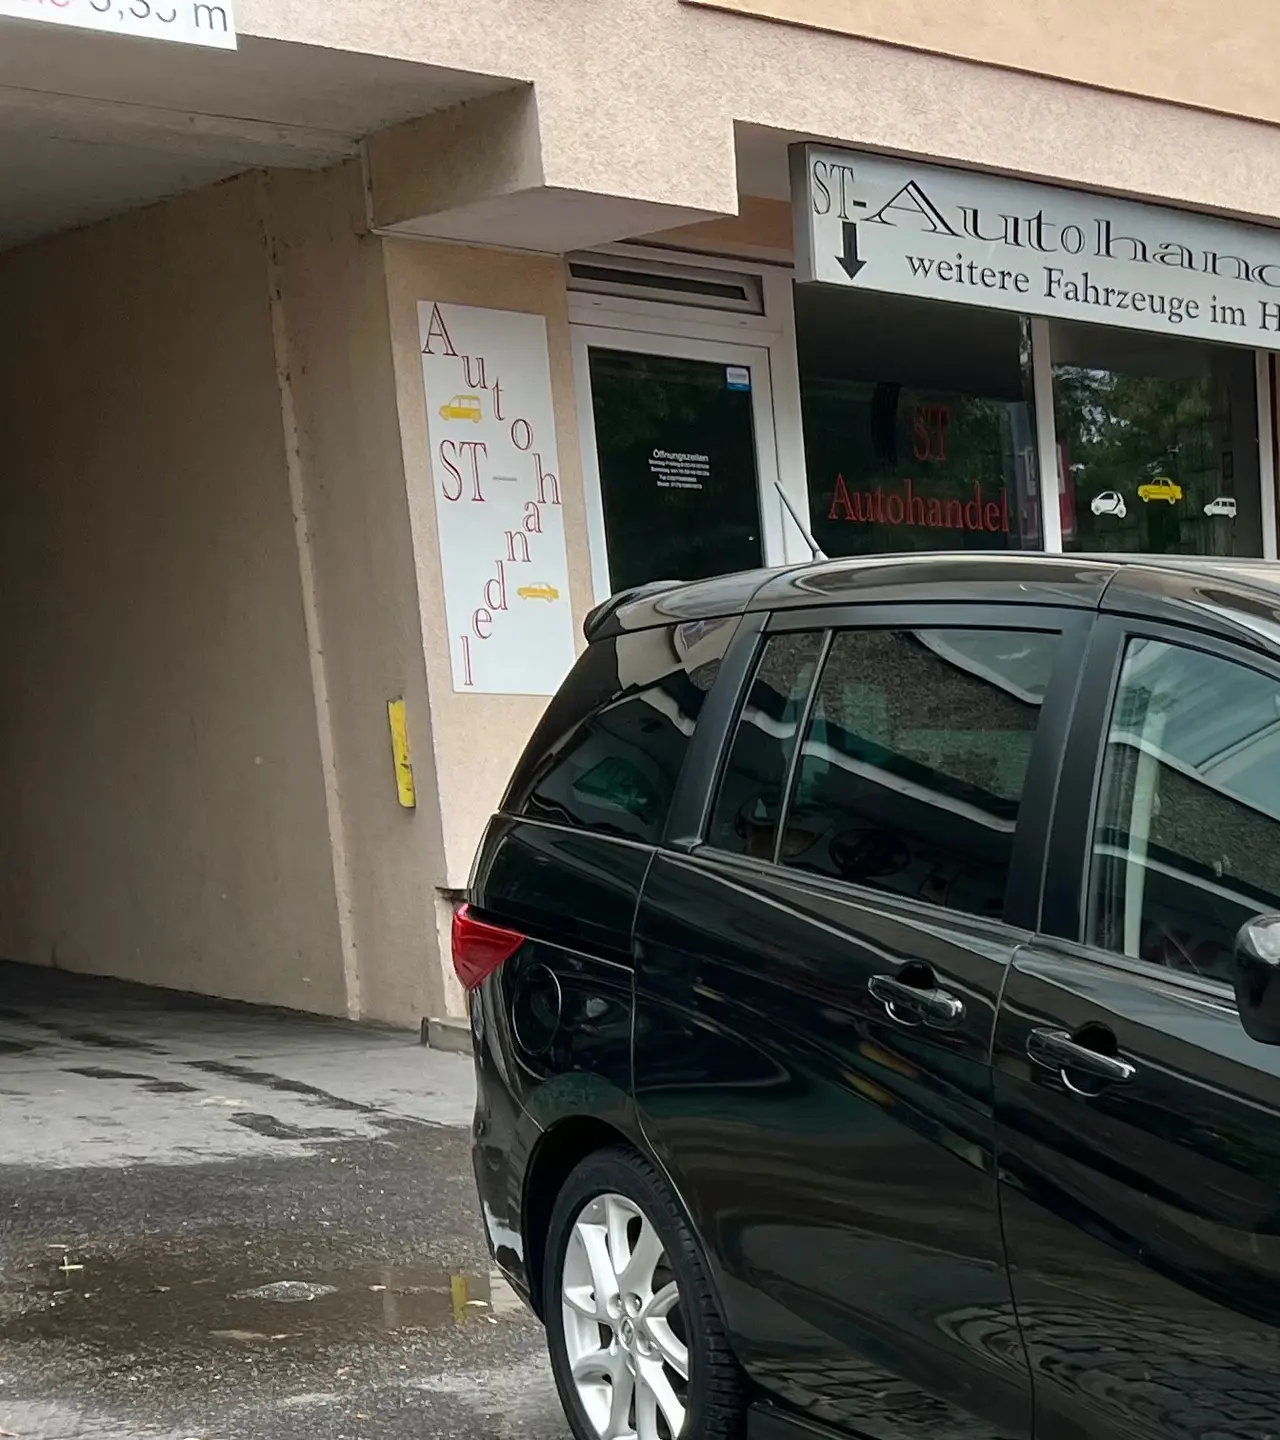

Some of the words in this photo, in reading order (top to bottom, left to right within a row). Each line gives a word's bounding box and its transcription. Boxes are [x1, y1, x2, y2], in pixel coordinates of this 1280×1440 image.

[193, 3, 228, 32] m
[905, 253, 1030, 293] weitere
[1043, 266, 1200, 324] Fahrzeuge
[1209, 294, 1247, 328] im
[912, 404, 949, 461] ST
[828, 472, 1010, 533] Autohandel
